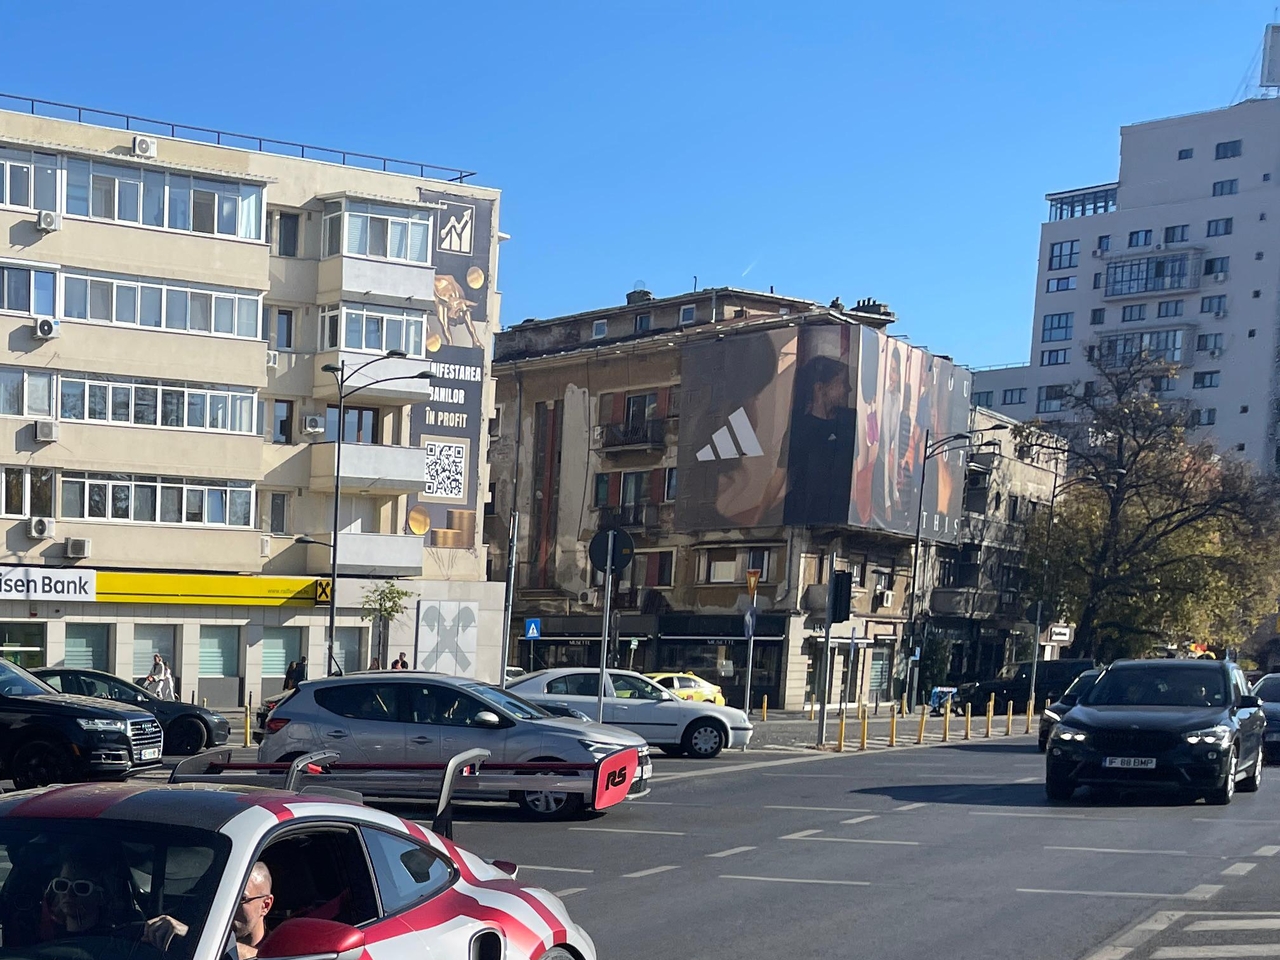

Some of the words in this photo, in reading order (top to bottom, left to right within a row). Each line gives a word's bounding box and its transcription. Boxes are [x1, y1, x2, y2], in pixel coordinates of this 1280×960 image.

[425, 406, 435, 425] ÎN
[438, 411, 468, 428] PROFIT
[41, 576, 89, 595] Bank
[605, 766, 627, 791] RS
